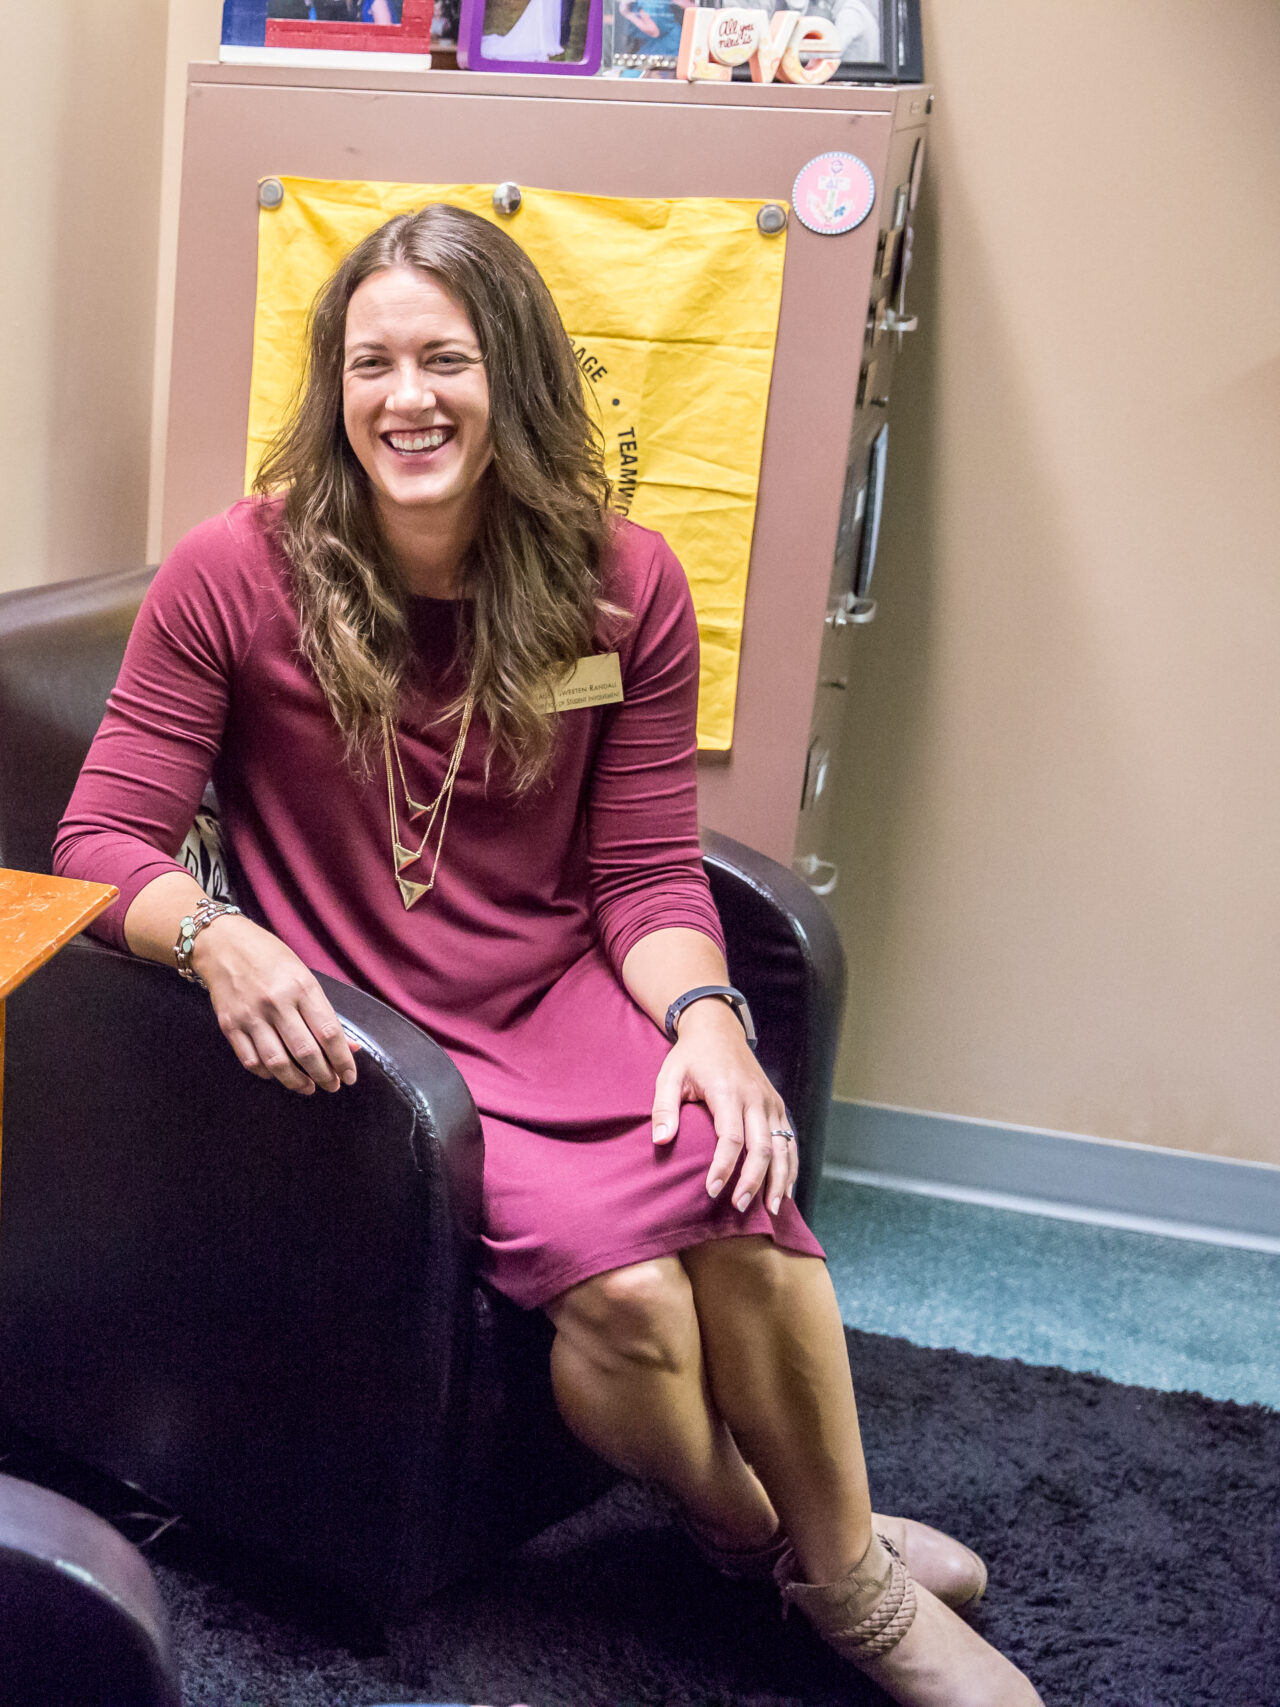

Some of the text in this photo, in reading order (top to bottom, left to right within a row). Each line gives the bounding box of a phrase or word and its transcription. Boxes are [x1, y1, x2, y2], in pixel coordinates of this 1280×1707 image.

[719, 18, 754, 39] All you
[719, 33, 753, 48] need is
